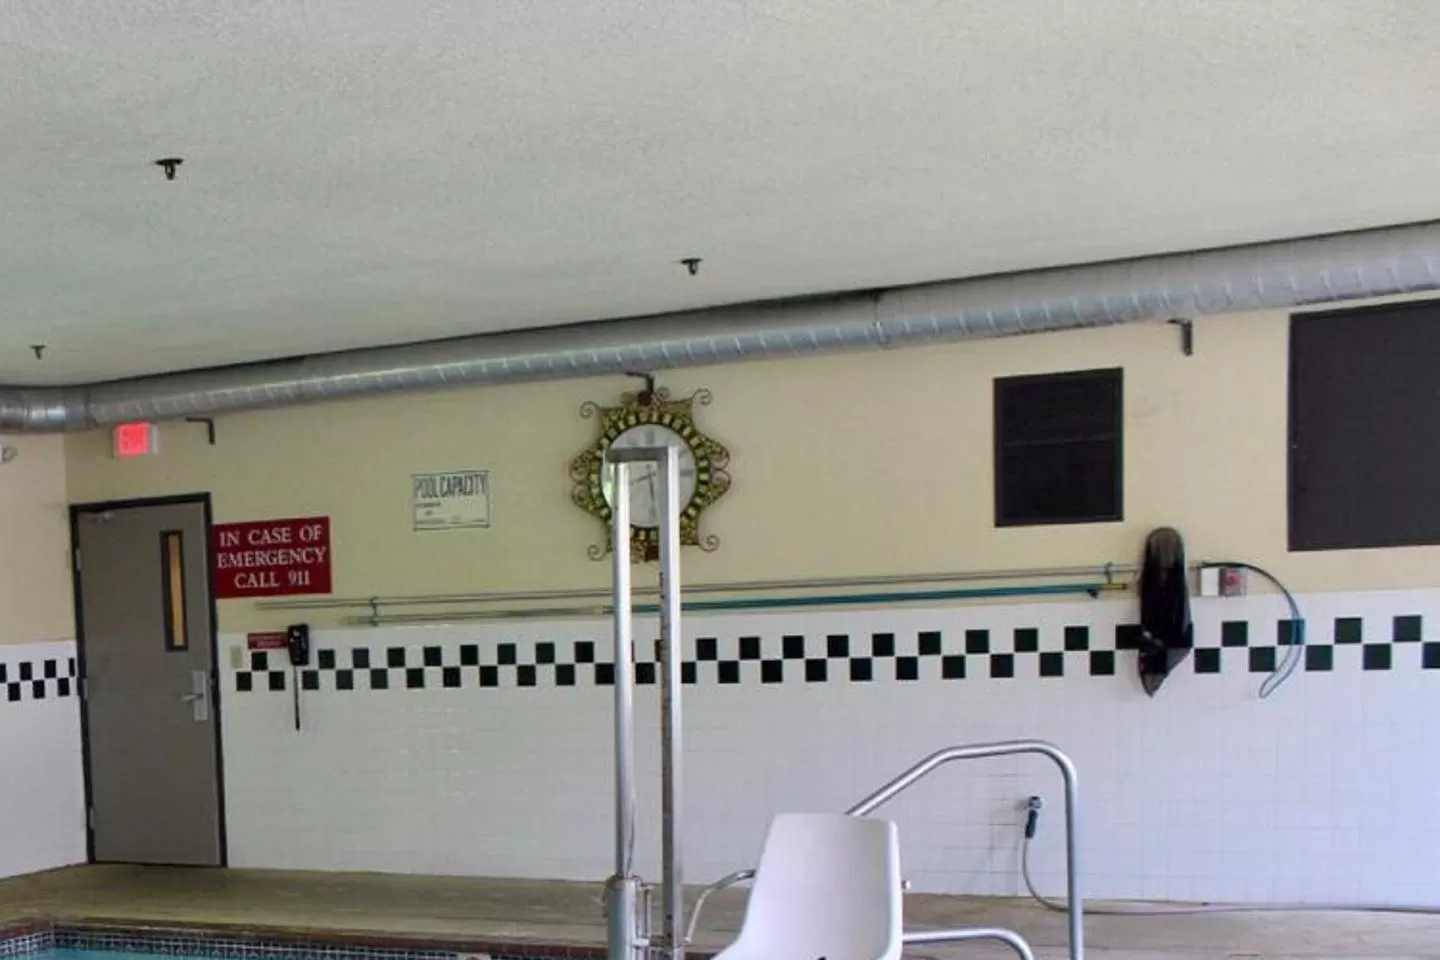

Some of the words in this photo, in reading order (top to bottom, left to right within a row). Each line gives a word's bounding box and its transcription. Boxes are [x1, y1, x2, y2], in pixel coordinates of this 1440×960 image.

[440, 474, 486, 497] CAPACITY
[219, 530, 241, 548] IN
[247, 527, 292, 546] CASE
[299, 524, 324, 542] OF
[216, 546, 328, 569] EMERGENCY
[233, 571, 280, 589] CALL
[287, 569, 311, 587] 911
